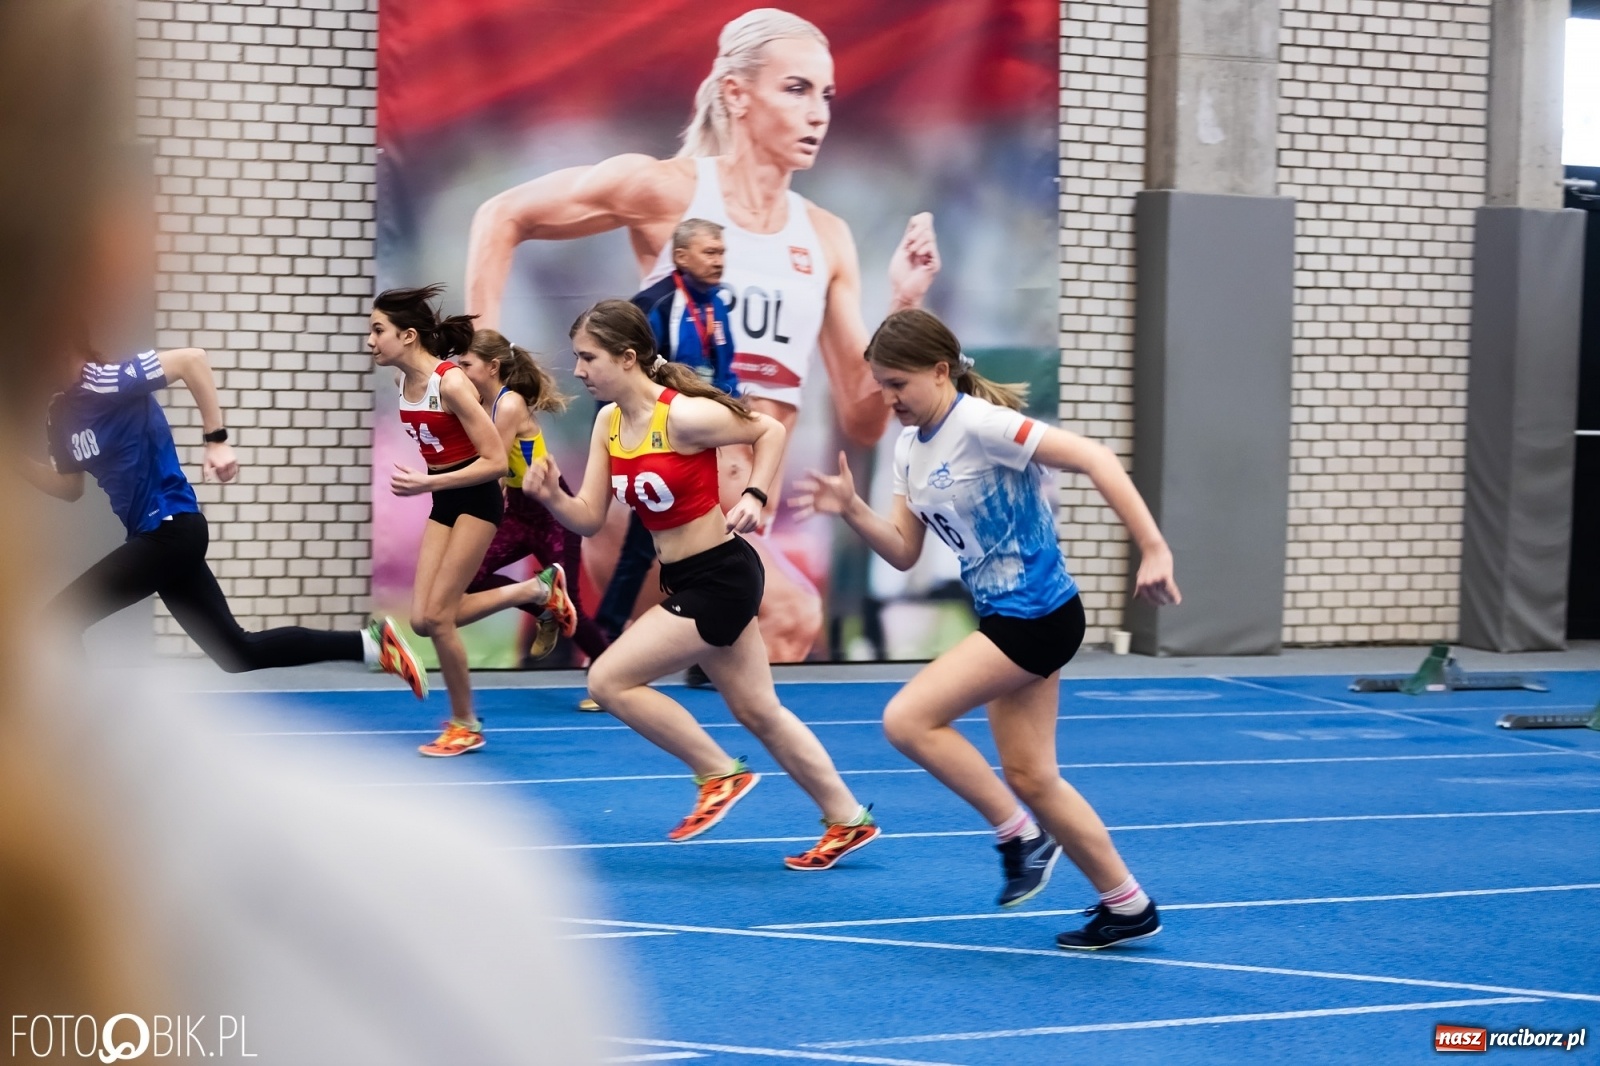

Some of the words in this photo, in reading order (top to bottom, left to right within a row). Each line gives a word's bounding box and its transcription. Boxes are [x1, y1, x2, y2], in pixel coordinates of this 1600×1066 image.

[71, 428, 101, 462] 309
[611, 471, 675, 512] 70
[920, 511, 965, 550] 16
